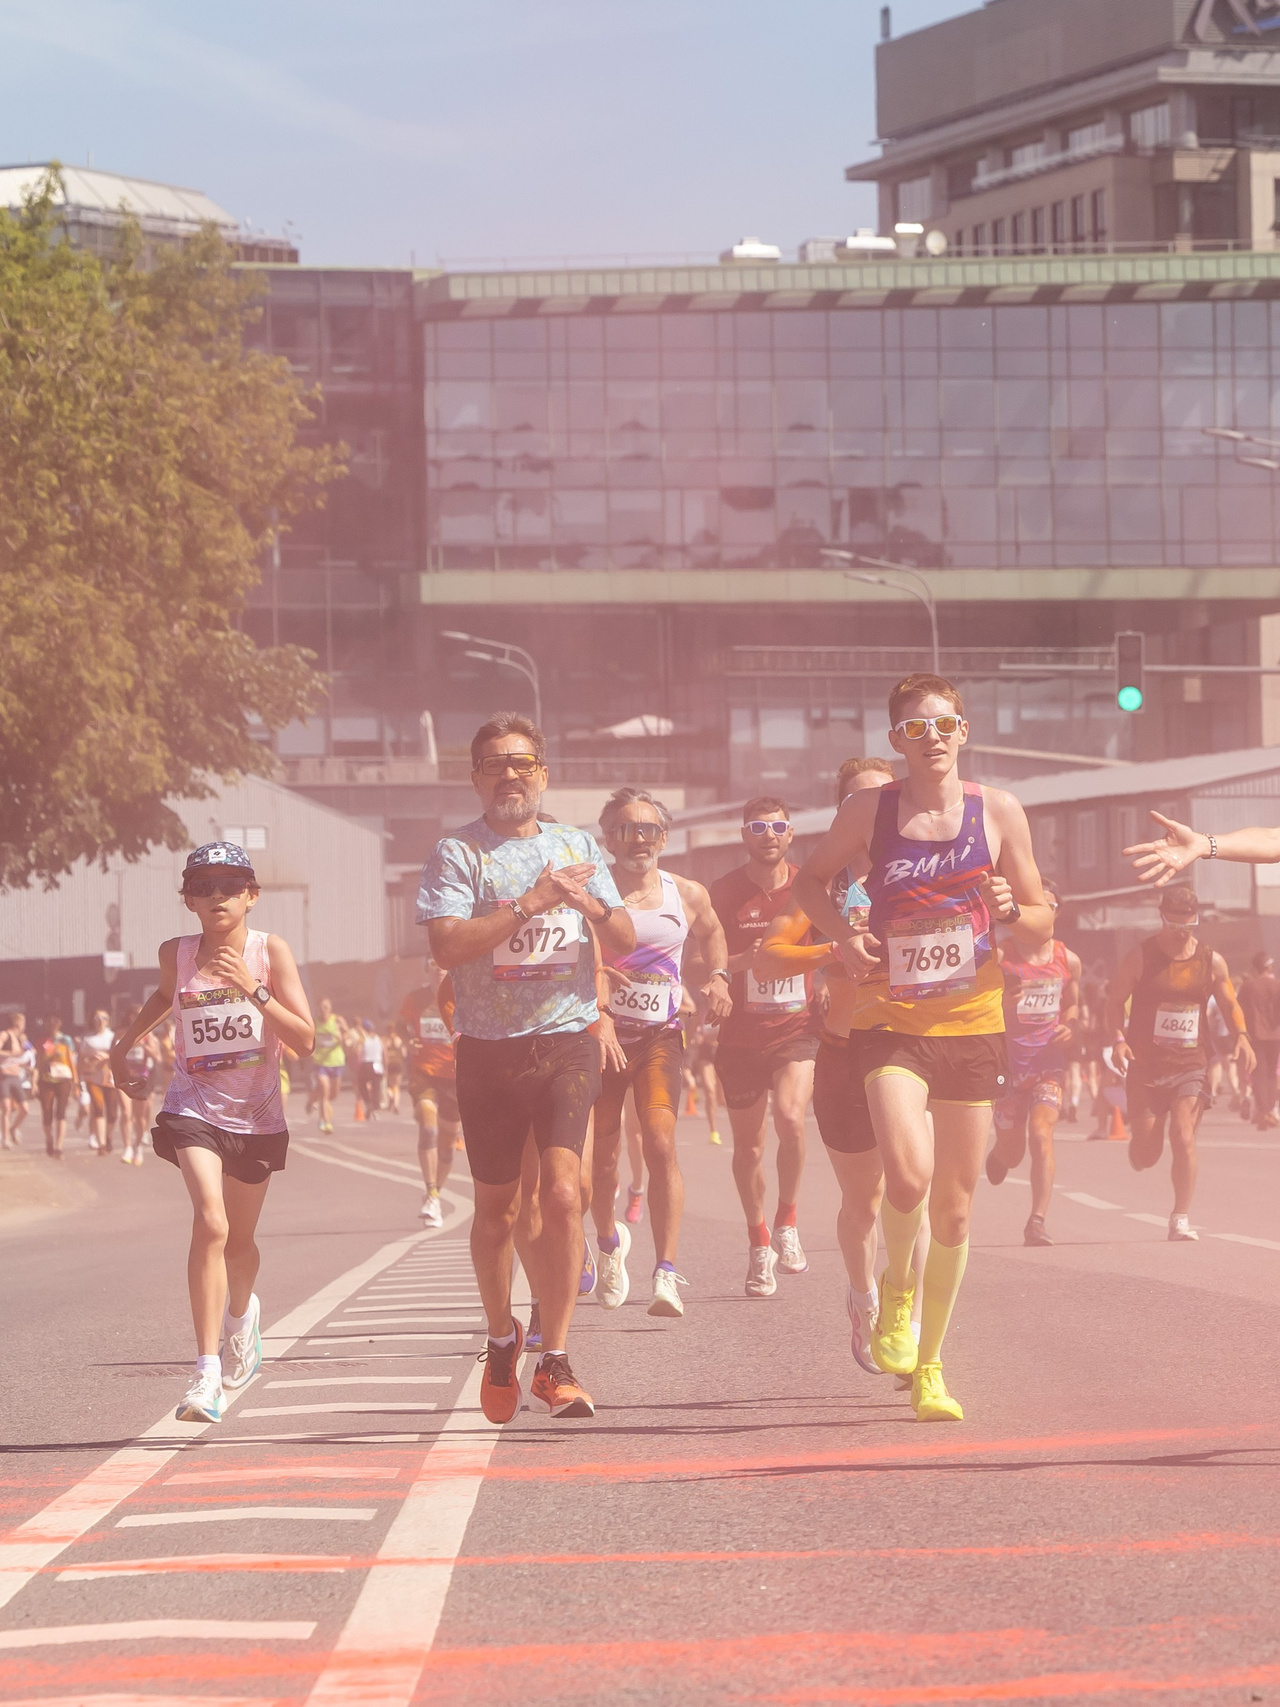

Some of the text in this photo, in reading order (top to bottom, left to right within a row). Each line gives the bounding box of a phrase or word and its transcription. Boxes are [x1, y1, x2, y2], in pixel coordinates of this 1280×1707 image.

[508, 926, 567, 954] 6172
[902, 943, 961, 973] 7698
[757, 977, 793, 995] 8171
[614, 988, 660, 1012] 3636
[1024, 993, 1055, 1008] 4773
[192, 1014, 253, 1045] 5563
[1160, 1018, 1194, 1033] 4842
